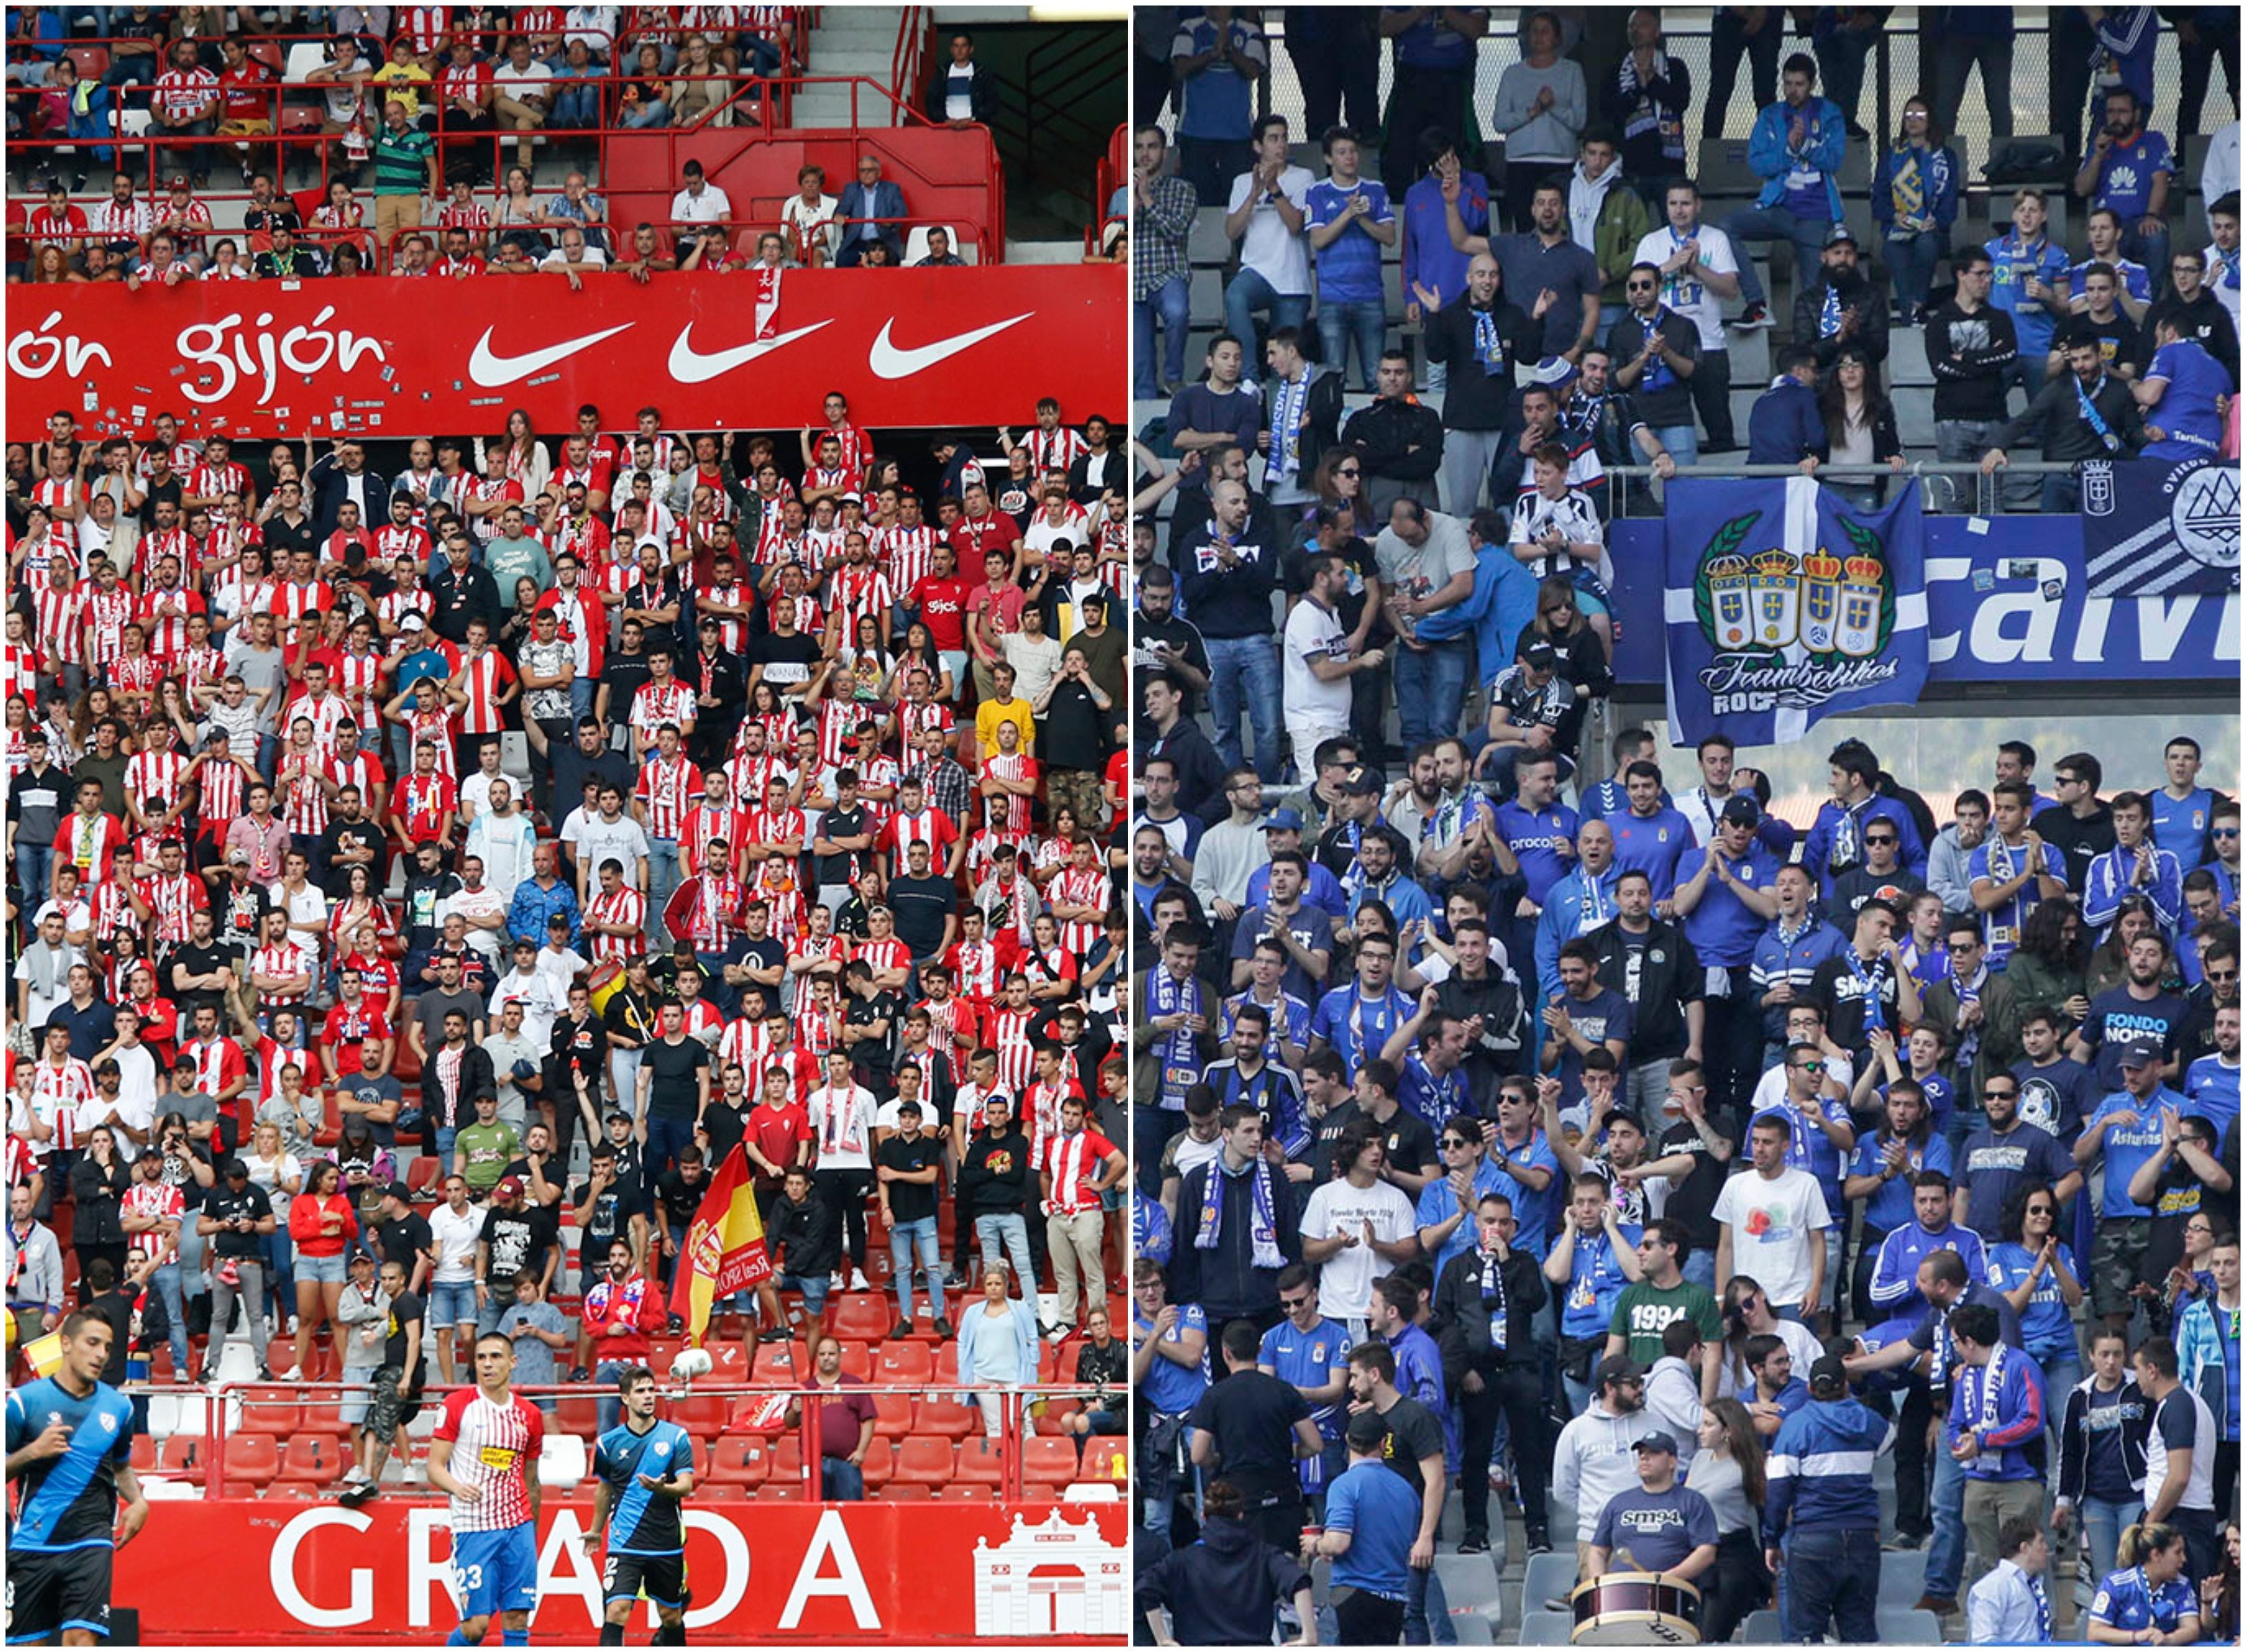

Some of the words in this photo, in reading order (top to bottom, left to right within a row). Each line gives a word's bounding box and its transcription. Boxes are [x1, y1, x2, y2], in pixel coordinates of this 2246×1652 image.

[176, 305, 386, 405] gijón
[1712, 691, 1778, 715] ROCF
[2106, 1012, 2168, 1033] FONDO
[2111, 1129, 2162, 1146] Asturias
[1631, 1305, 1686, 1331] 1994
[456, 1564, 482, 1594] 23
